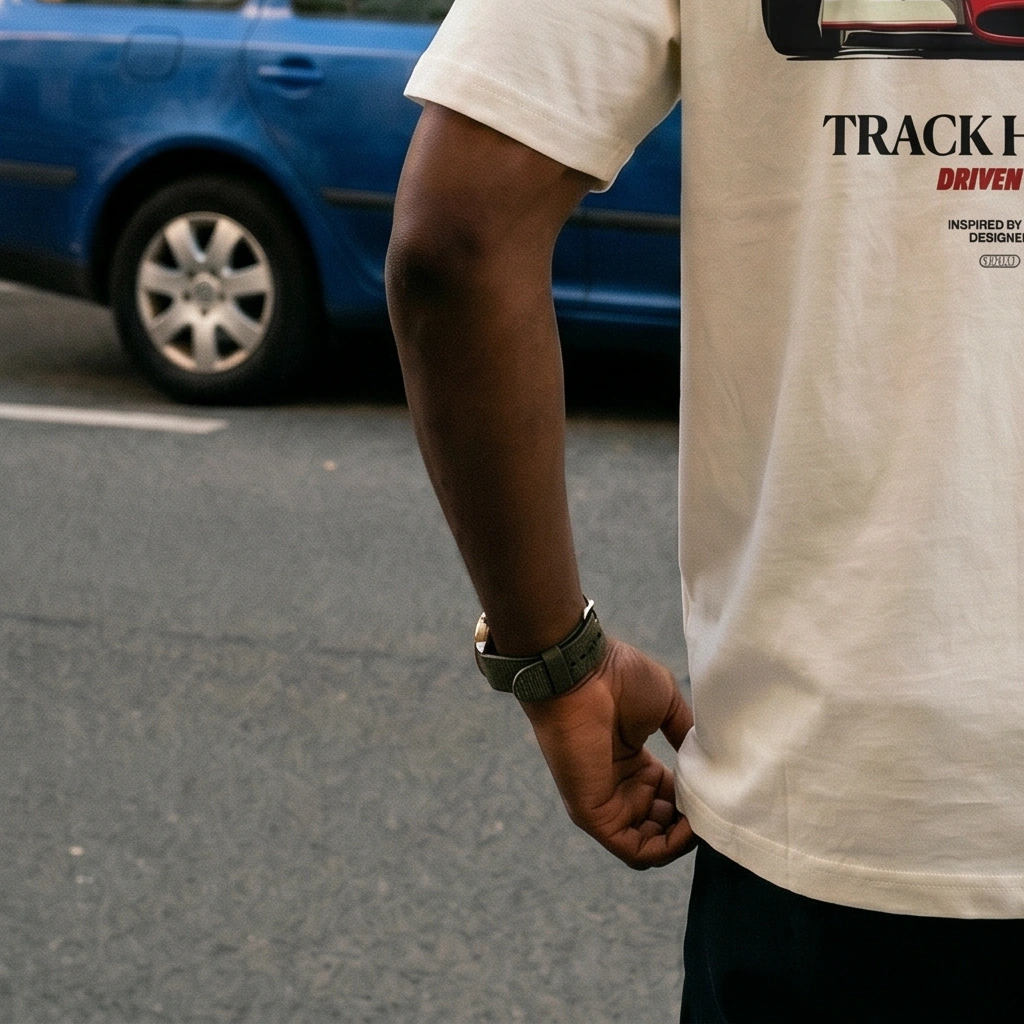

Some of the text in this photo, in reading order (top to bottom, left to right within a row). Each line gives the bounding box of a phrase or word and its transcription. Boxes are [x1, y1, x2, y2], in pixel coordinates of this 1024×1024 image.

[823, 114, 993, 156] TRACK
[936, 167, 1024, 191] DRIVEN
[948, 219, 1004, 230] INSPIRED
[1006, 219, 1022, 230] BY
